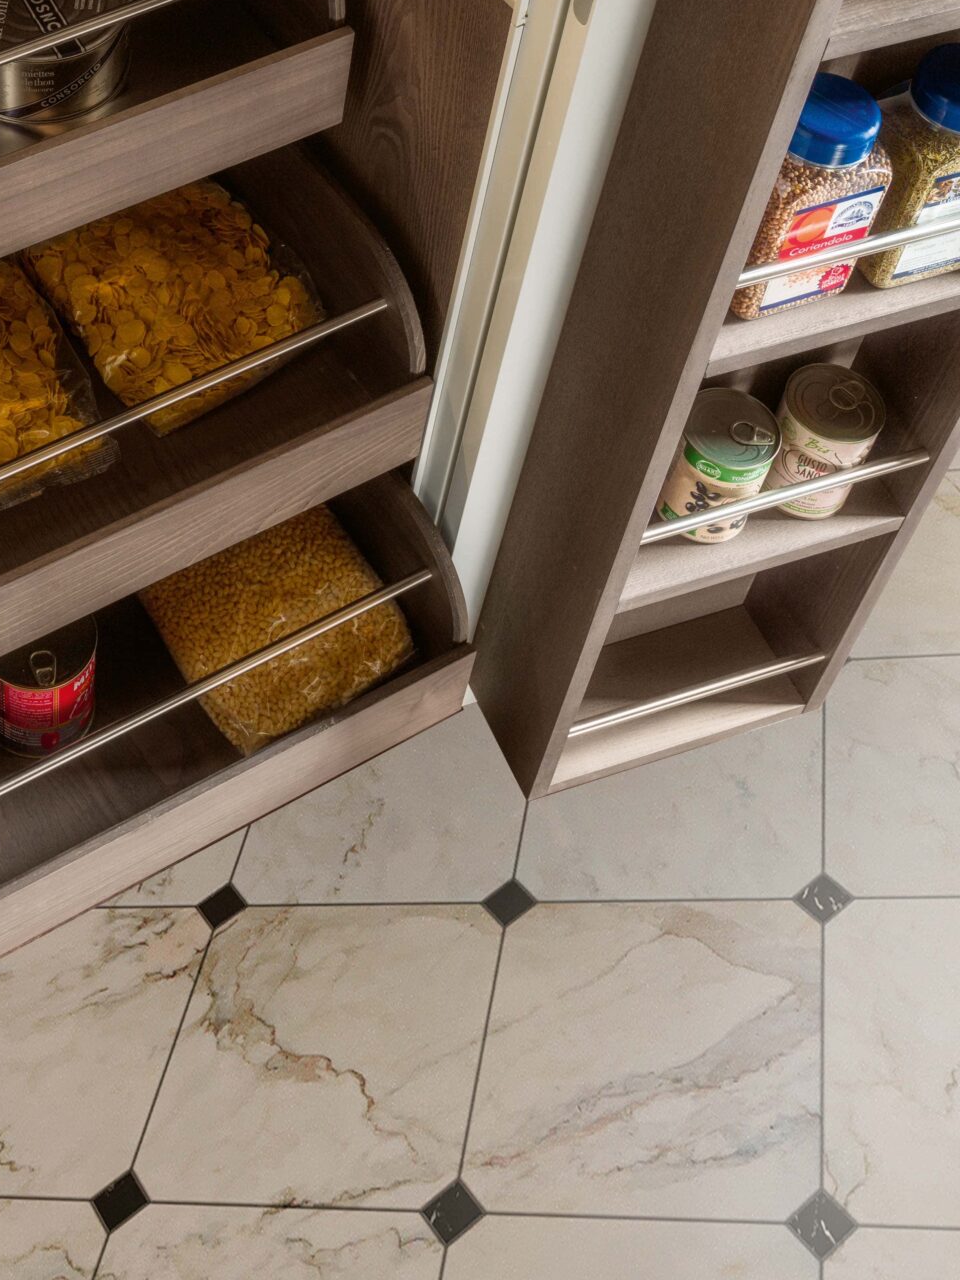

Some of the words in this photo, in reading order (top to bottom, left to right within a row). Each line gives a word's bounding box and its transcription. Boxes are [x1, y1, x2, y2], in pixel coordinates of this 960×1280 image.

[40, 62, 102, 108] CONSORCIO
[789, 234, 852, 259] Coriandolo
[797, 454, 828, 472] GUSTO
